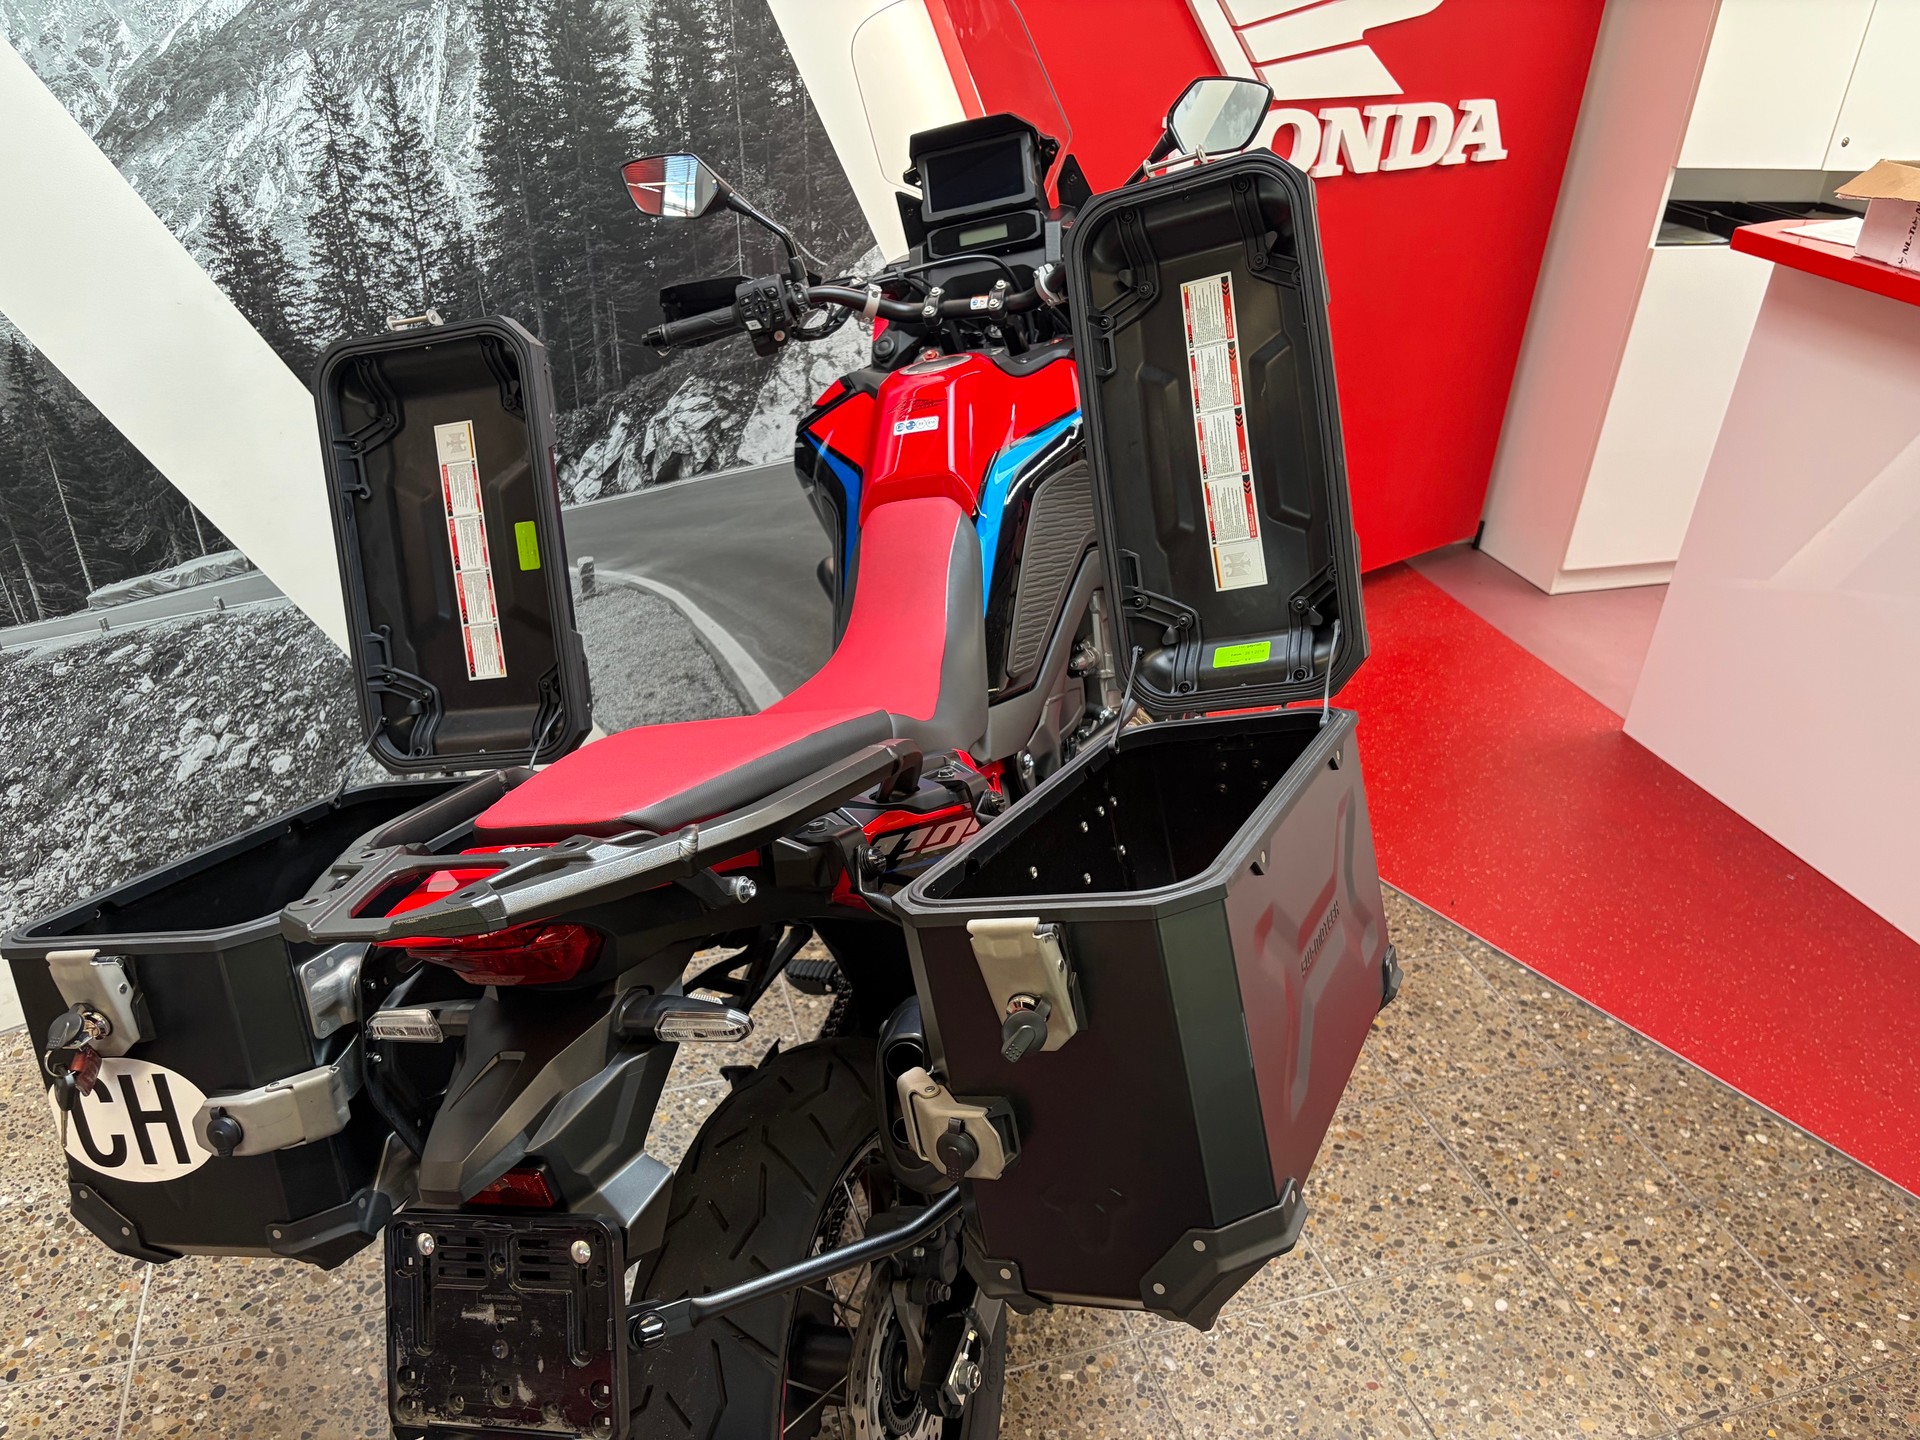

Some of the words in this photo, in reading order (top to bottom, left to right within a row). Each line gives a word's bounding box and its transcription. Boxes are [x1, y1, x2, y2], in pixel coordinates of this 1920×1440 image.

[1162, 98, 1508, 178] ONDA
[873, 817, 981, 859] 110
[70, 1073, 191, 1168] CH
